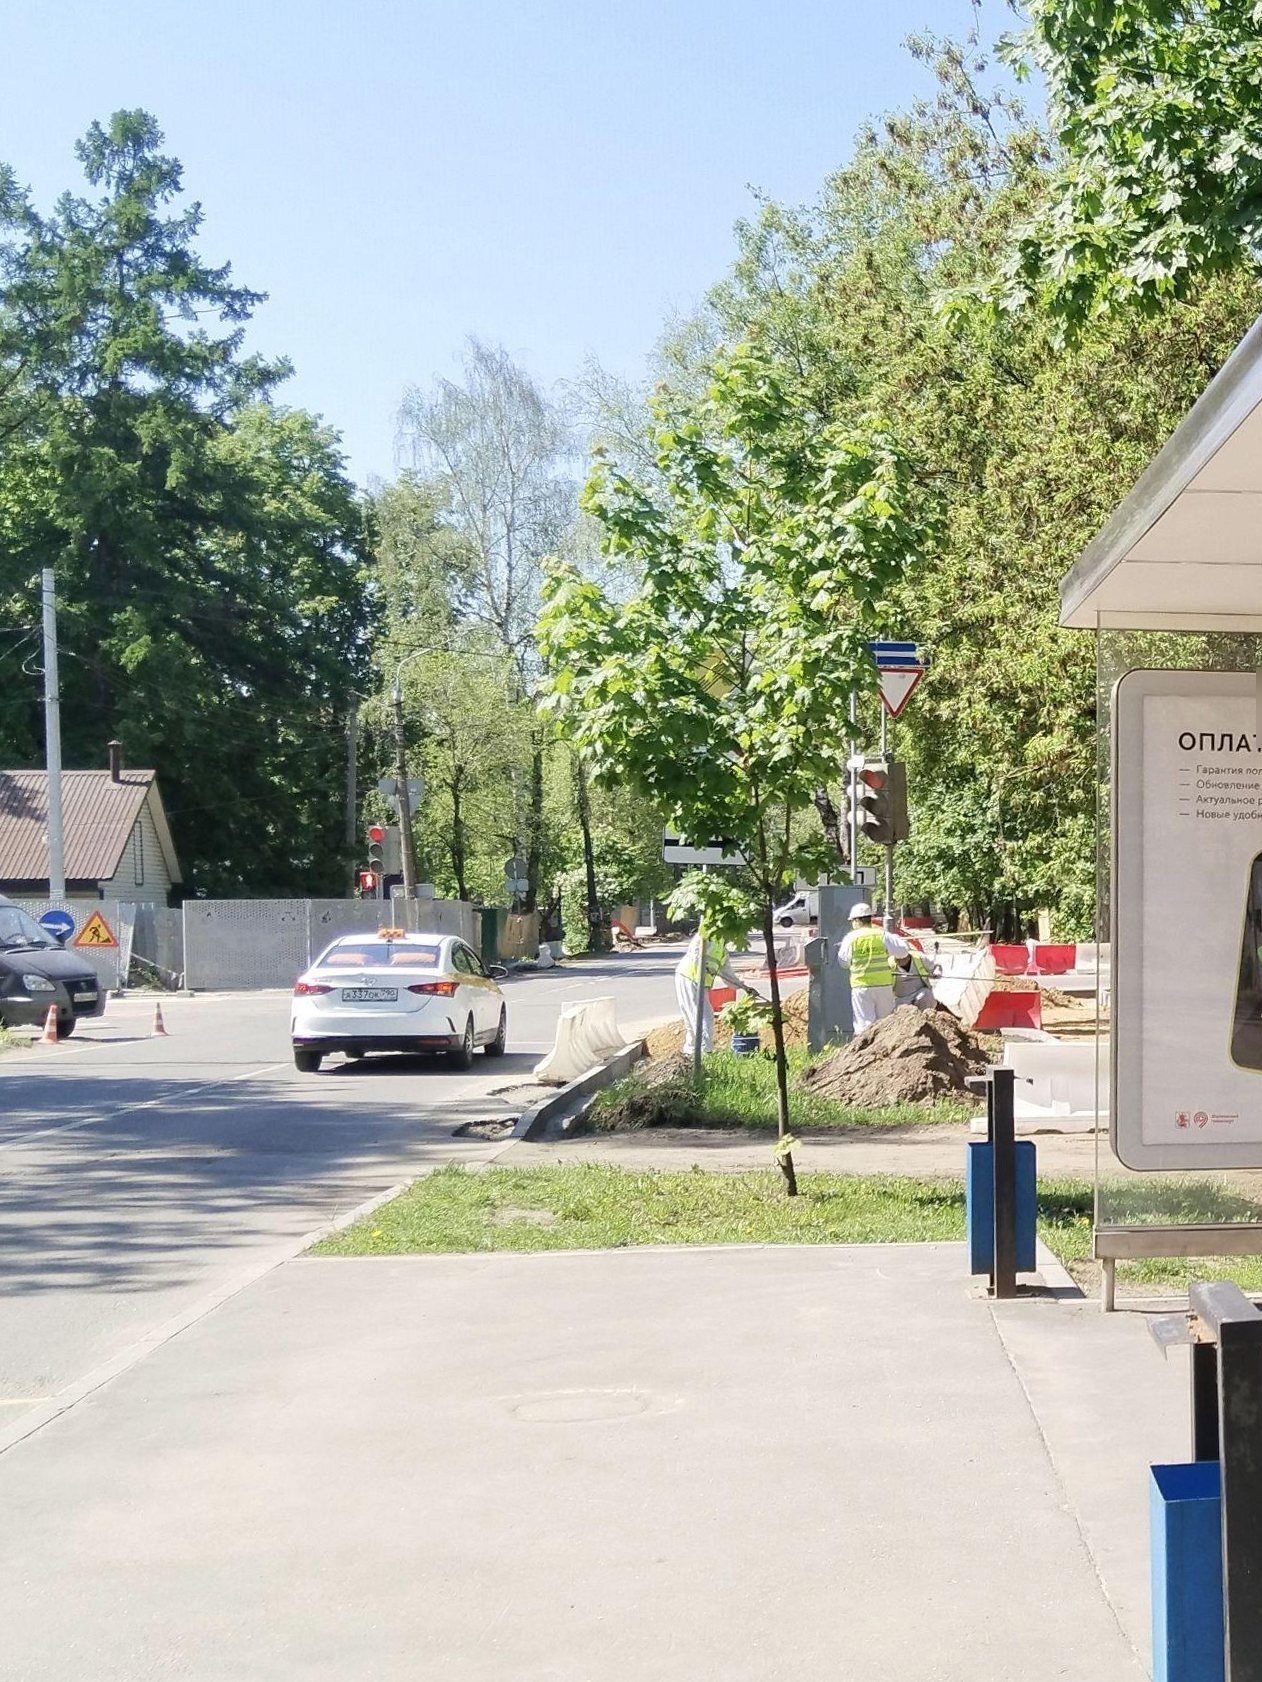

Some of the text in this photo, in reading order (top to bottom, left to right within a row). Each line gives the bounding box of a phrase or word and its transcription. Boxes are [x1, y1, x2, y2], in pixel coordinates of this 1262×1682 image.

[1196, 764, 1243, 775] Гарантия
[1196, 779, 1260, 789] Обновление
[1196, 794, 1255, 806] Актуальное
[1196, 810, 1230, 819] Новые
